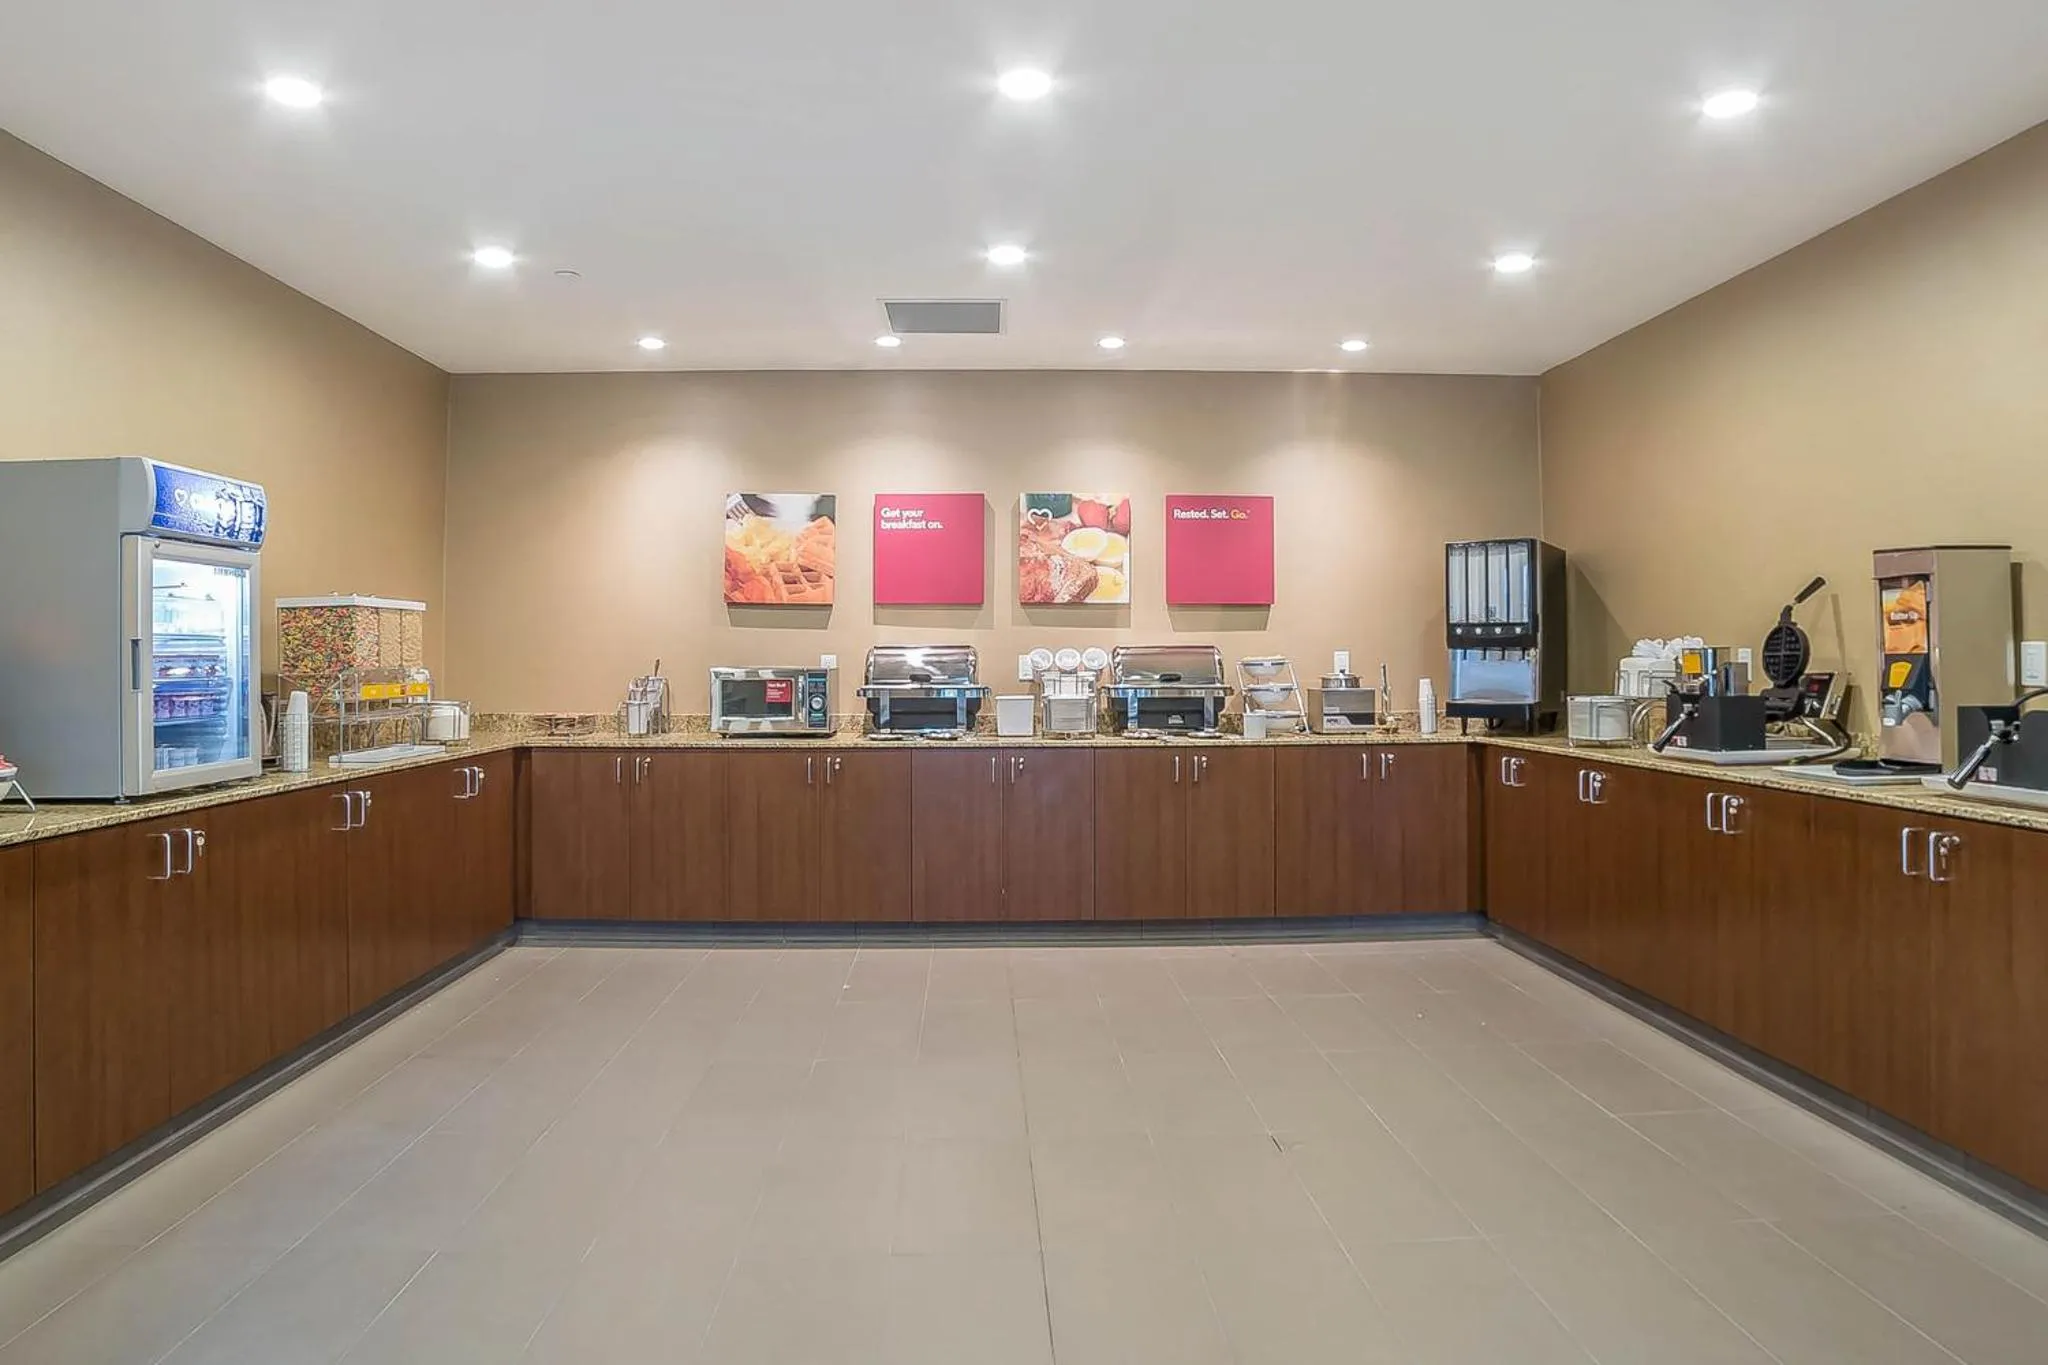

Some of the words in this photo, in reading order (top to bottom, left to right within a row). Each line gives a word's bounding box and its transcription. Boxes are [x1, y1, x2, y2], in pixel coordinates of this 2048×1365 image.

[881, 507, 901, 518] Get
[901, 508, 924, 520] your
[1173, 508, 1209, 519] Rested.
[1210, 508, 1229, 519] Set.
[881, 519, 926, 529] breakfast
[927, 521, 944, 529] on.
